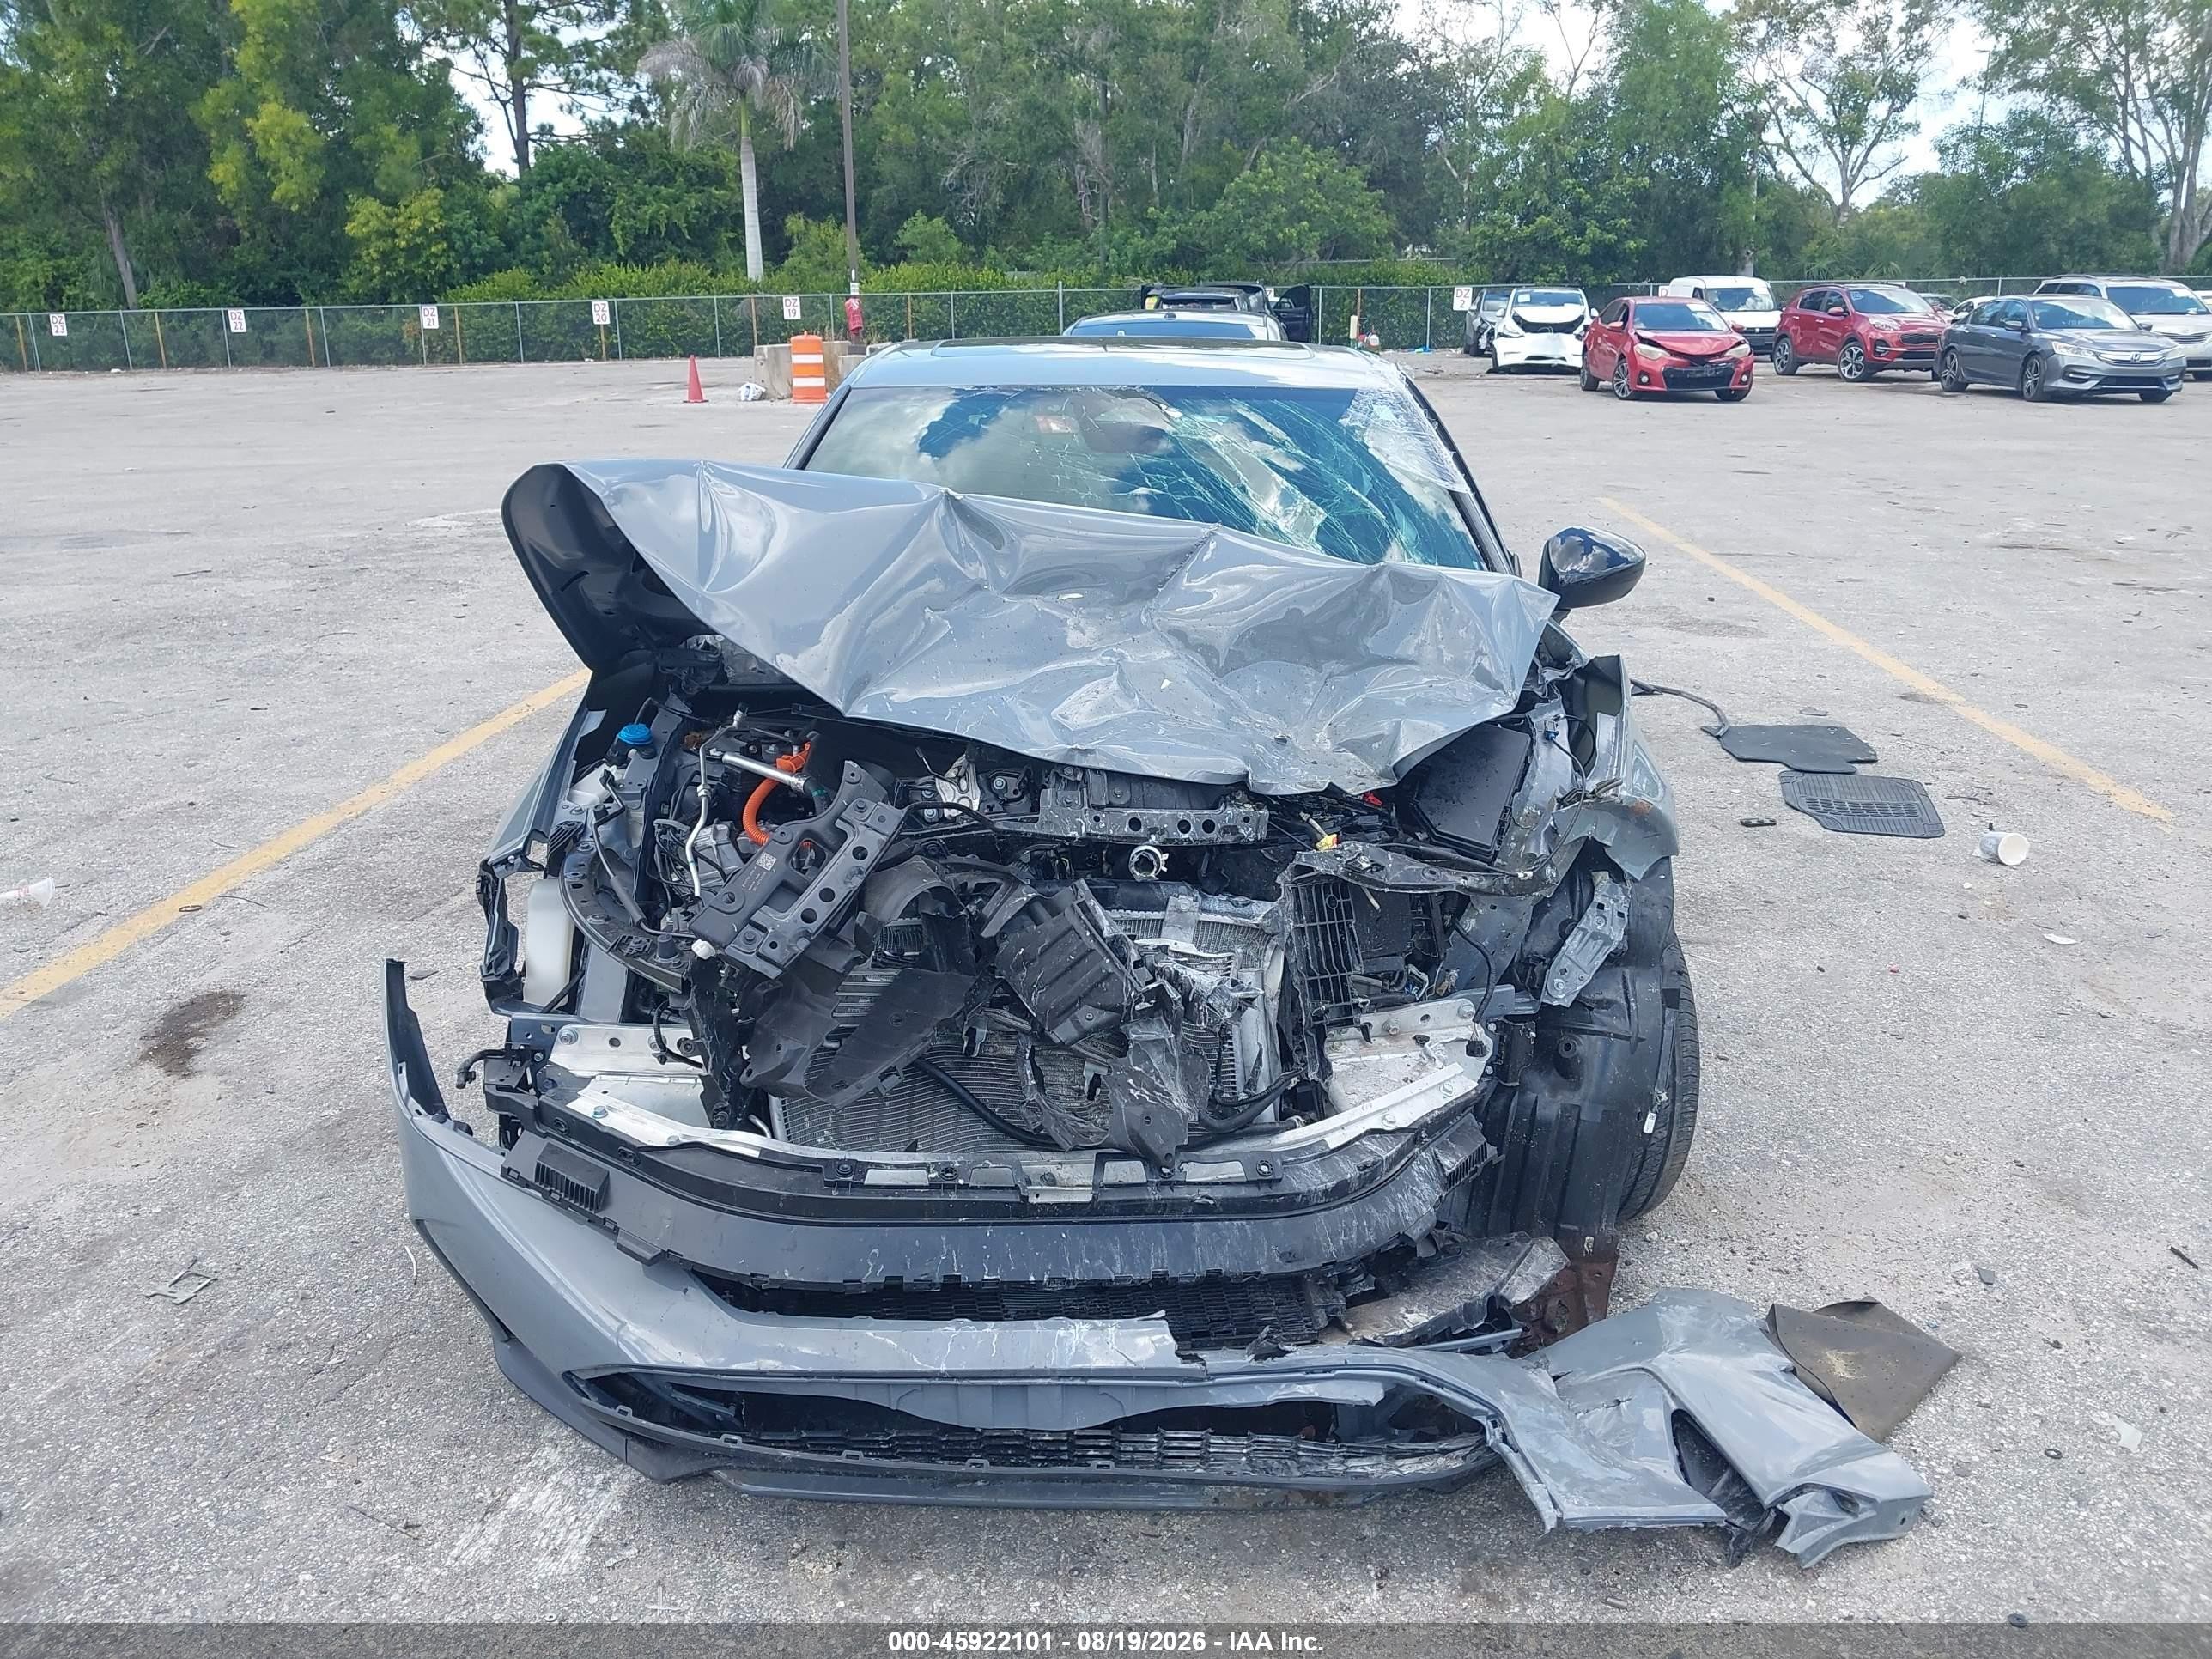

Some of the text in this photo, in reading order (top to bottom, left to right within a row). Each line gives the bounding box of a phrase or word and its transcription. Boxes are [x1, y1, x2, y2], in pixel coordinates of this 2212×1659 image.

[1455, 289, 1470, 298] DZ
[784, 298, 799, 307] DZ
[422, 307, 436, 317] DZ
[593, 303, 607, 313] DZ
[229, 311, 243, 320] DZ
[595, 313, 607, 322] 20
[787, 308, 797, 318] 19
[51, 315, 64, 325] DZ
[426, 318, 435, 326] 21
[54, 325, 65, 334] 23
[233, 321, 244, 330] 22
